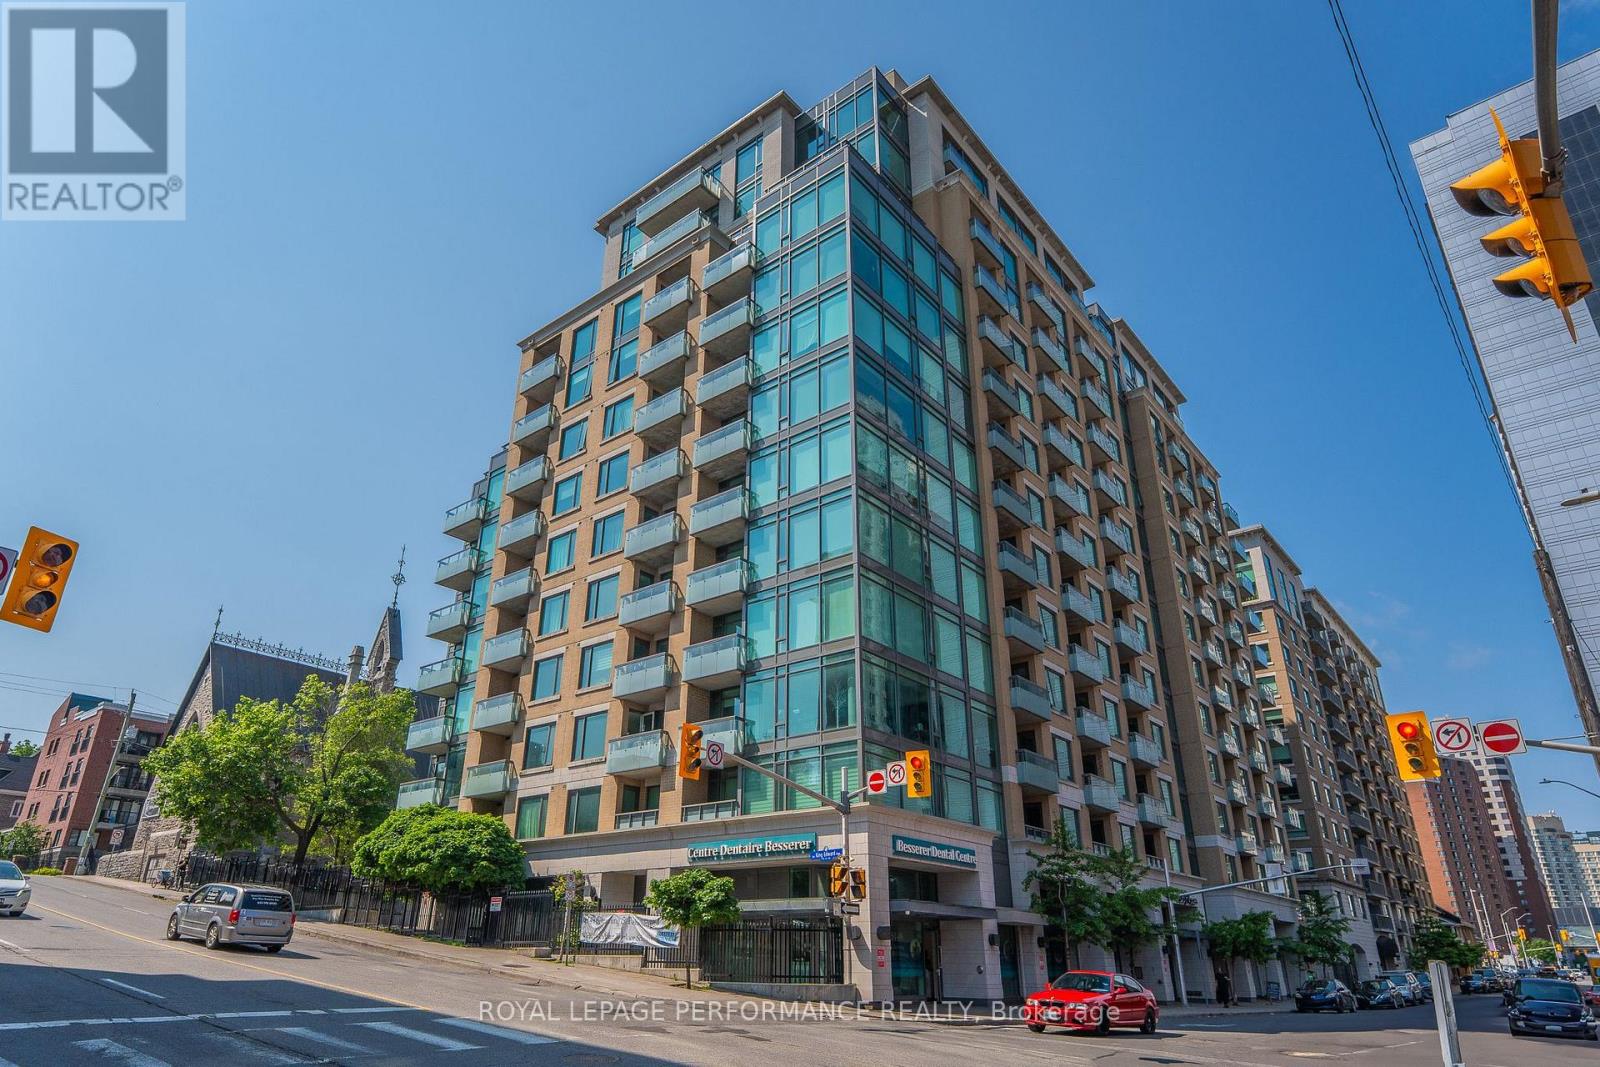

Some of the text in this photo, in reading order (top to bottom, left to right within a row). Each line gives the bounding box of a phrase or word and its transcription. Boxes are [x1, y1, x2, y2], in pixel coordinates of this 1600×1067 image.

[688, 839, 811, 858] Centre Dentaire Besserer
[896, 839, 978, 864] Besserer Dental Centre
